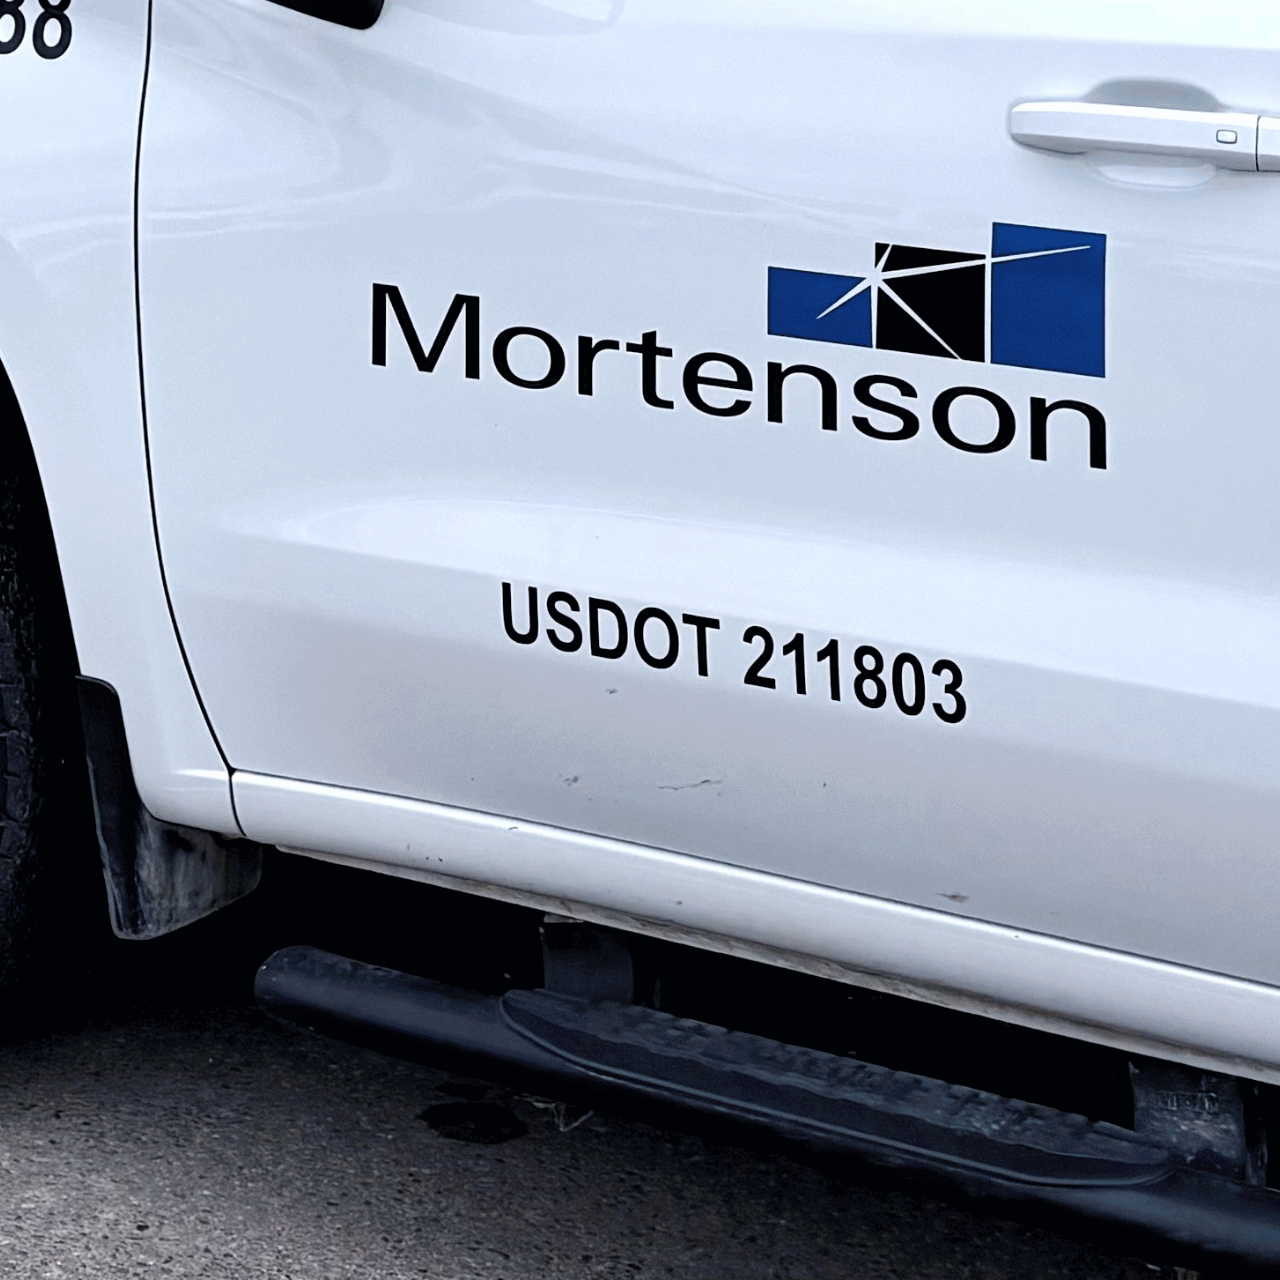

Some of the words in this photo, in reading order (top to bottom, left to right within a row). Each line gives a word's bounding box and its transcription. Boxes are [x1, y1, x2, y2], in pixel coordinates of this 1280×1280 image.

[371, 282, 1107, 470] Mortenson
[501, 581, 720, 678] USDOT
[742, 625, 967, 724] 211803
